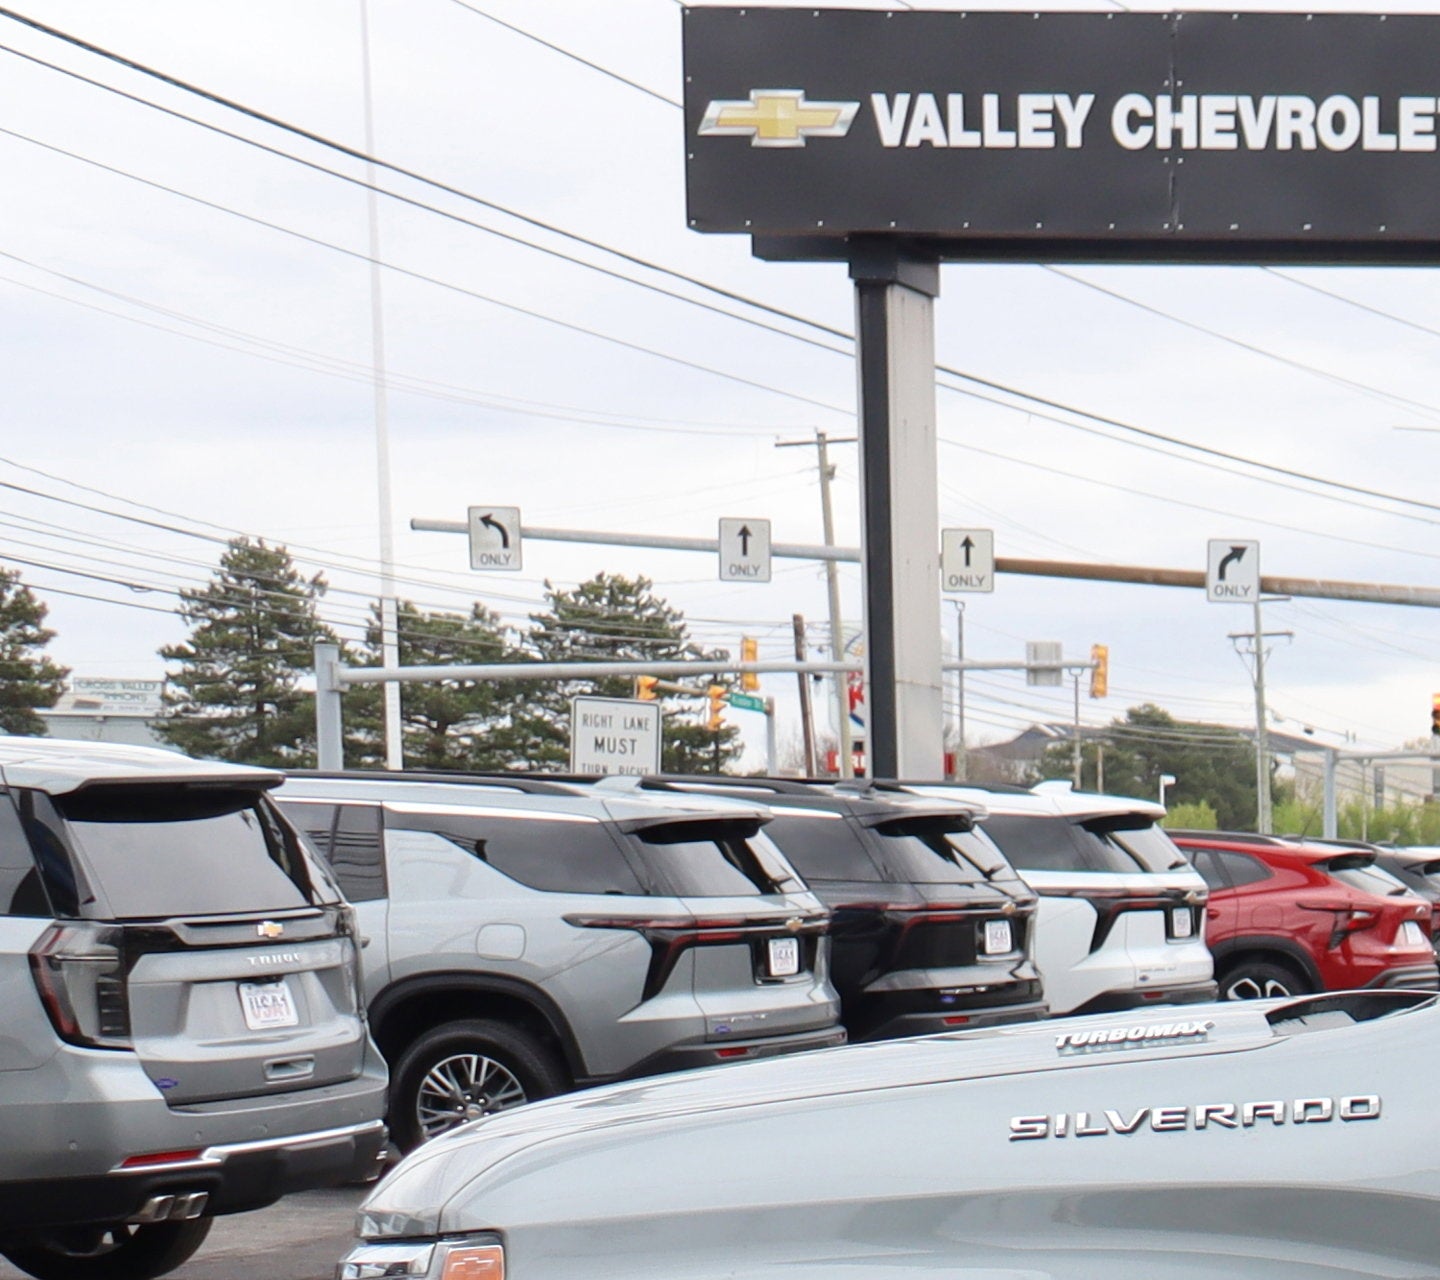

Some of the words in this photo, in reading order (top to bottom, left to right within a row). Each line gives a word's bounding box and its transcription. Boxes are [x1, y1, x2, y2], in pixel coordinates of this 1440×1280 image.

[871, 92, 1094, 149] VALLEY
[480, 553, 511, 566] ONLY
[729, 563, 760, 576] ONLY
[949, 575, 986, 587] ONLY
[1214, 585, 1250, 597] ONLY
[582, 713, 612, 728] RIGHT
[623, 716, 650, 731] LANE
[594, 736, 637, 754] MUST
[581, 763, 608, 774] TURN
[1055, 1020, 1216, 1048] TURBOMAX
[1008, 1094, 1382, 1141] SILVERADO
